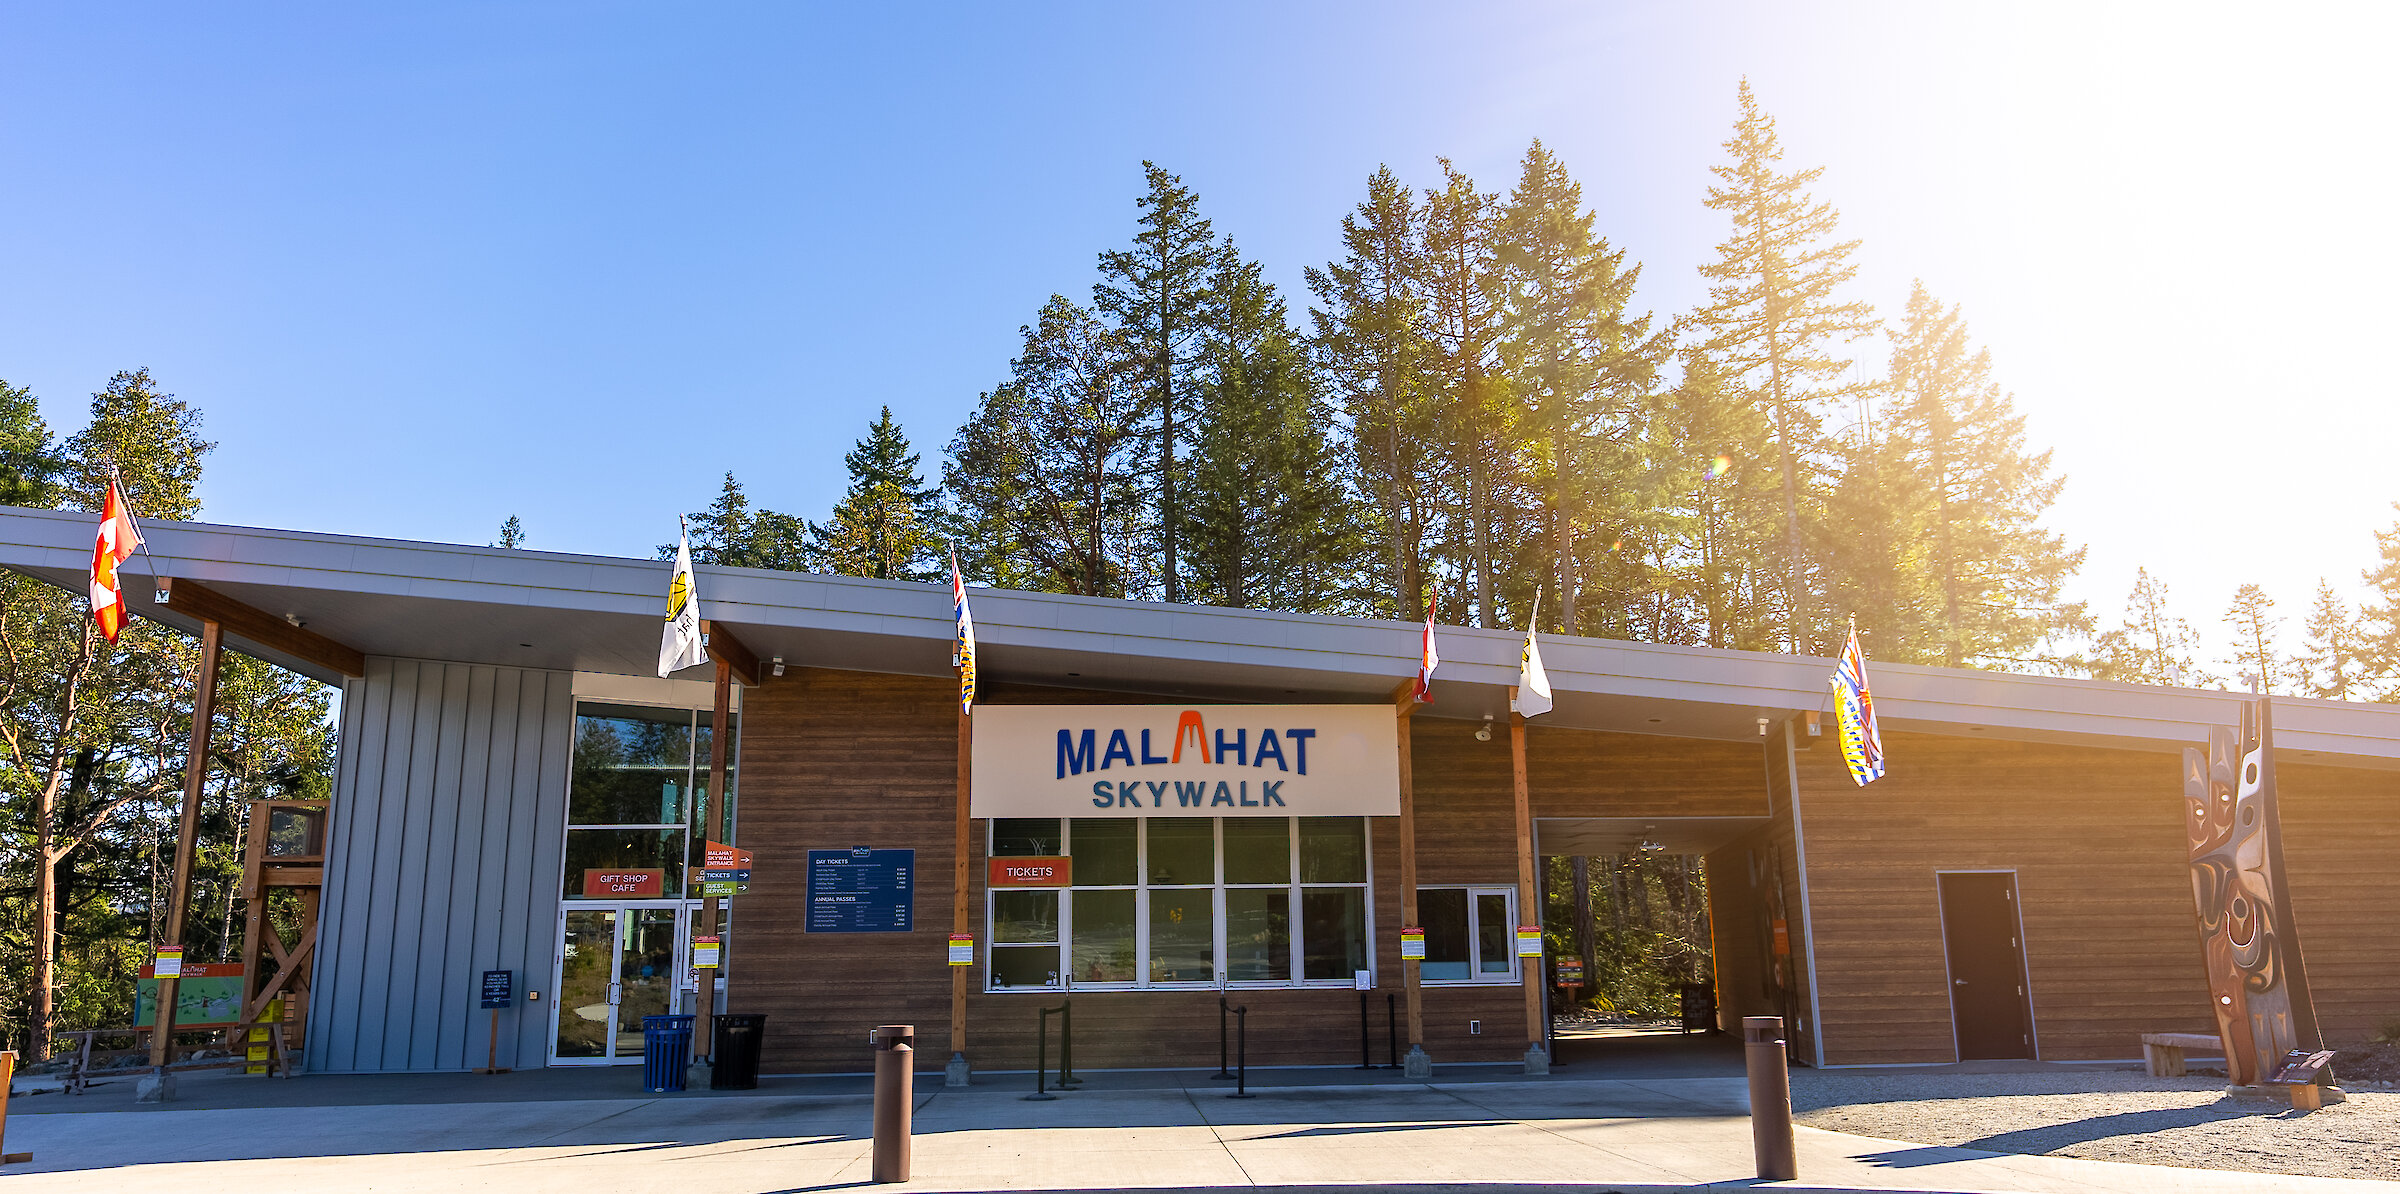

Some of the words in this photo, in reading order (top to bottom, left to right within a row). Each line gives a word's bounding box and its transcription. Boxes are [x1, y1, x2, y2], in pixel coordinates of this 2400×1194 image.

[1056, 710, 1316, 779] MALAHAT
[1092, 780, 1286, 808] SKYWALK
[1006, 867, 1053, 876] TICKETS
[600, 875, 620, 883] GIFT
[623, 874, 648, 883] SHOP
[610, 884, 636, 892] CAFE
